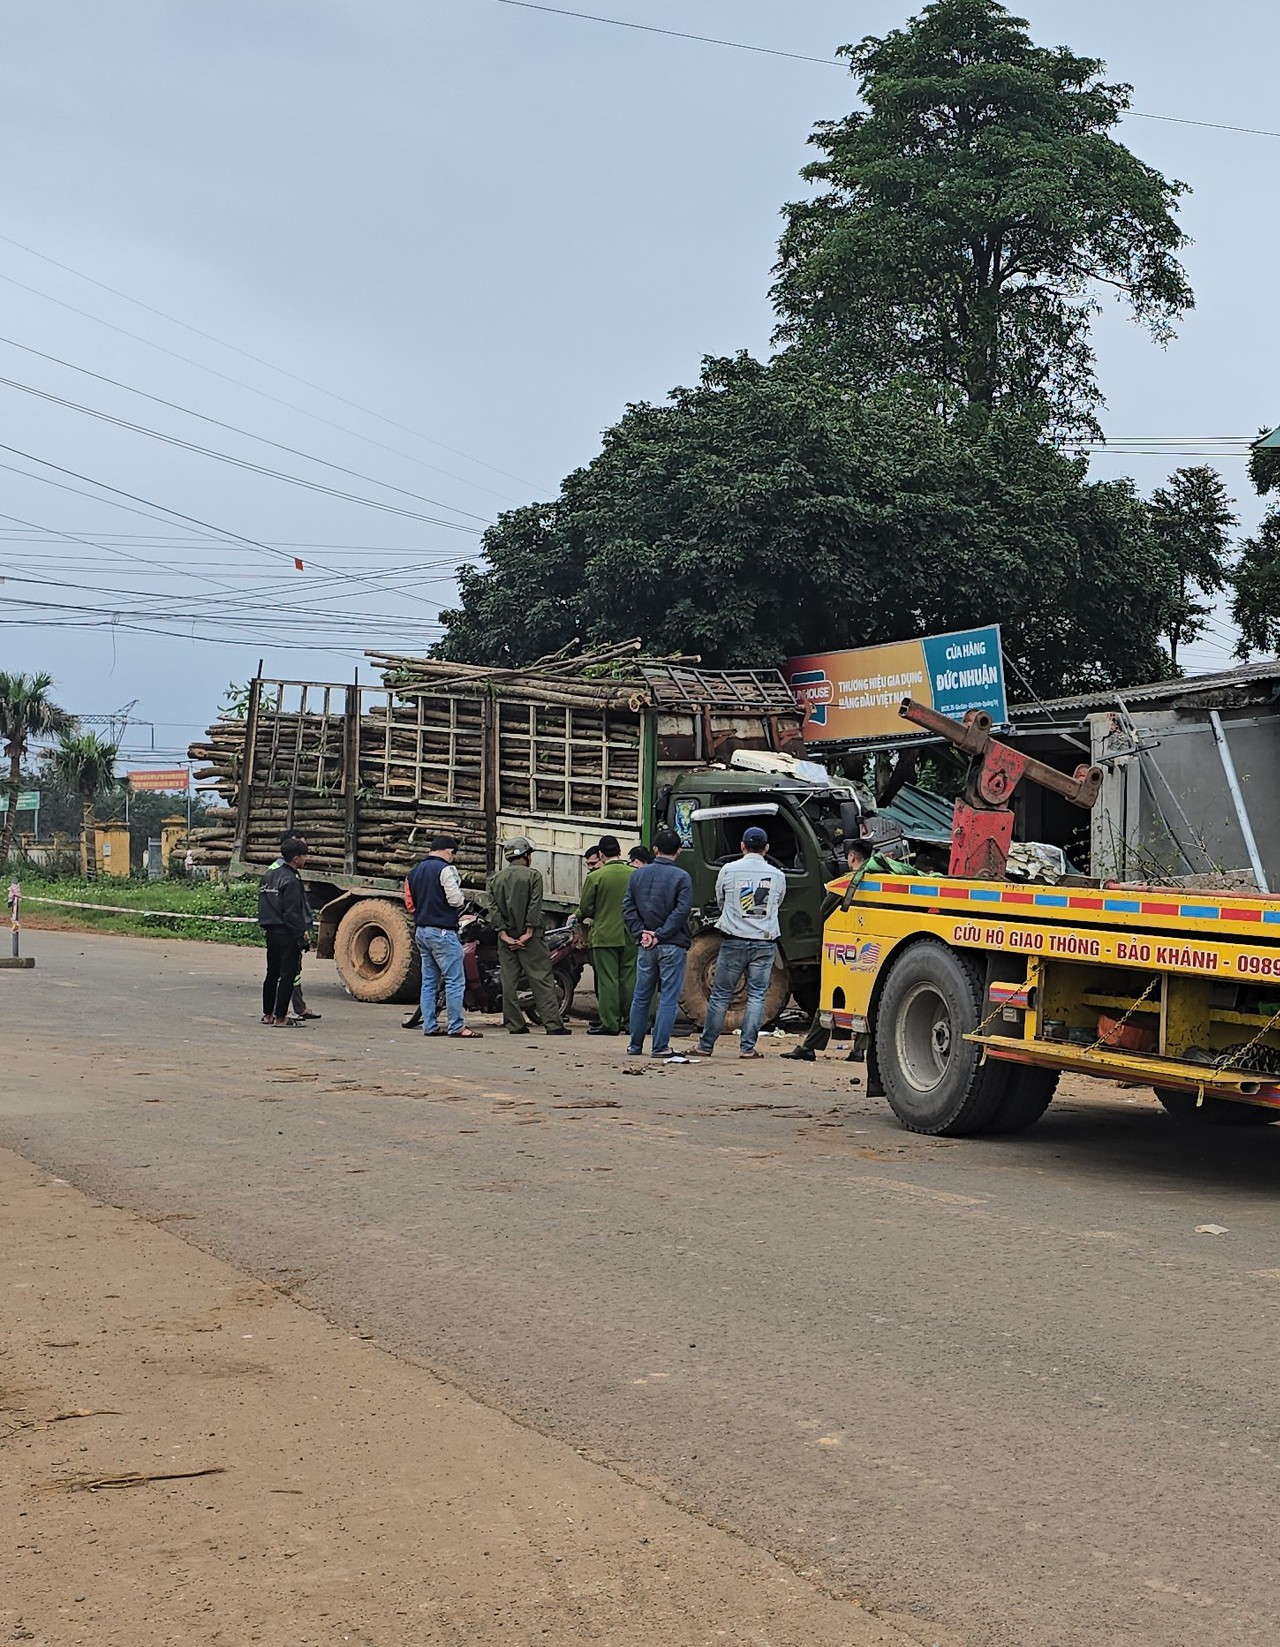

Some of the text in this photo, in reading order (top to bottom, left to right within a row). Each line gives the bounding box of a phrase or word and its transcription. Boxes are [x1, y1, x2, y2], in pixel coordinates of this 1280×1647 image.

[887, 674, 901, 687] GIA
[901, 670, 923, 688] DỤNG
[936, 664, 998, 691] ĐỨC NHUẬN
[953, 922, 981, 942] CỨU
[985, 927, 1004, 948] HỘ
[1009, 931, 1043, 949] GIAO
[1049, 932, 1100, 956] THÔNG
[1117, 937, 1150, 961] BẢO
[1156, 945, 1218, 970] KHÁNH
